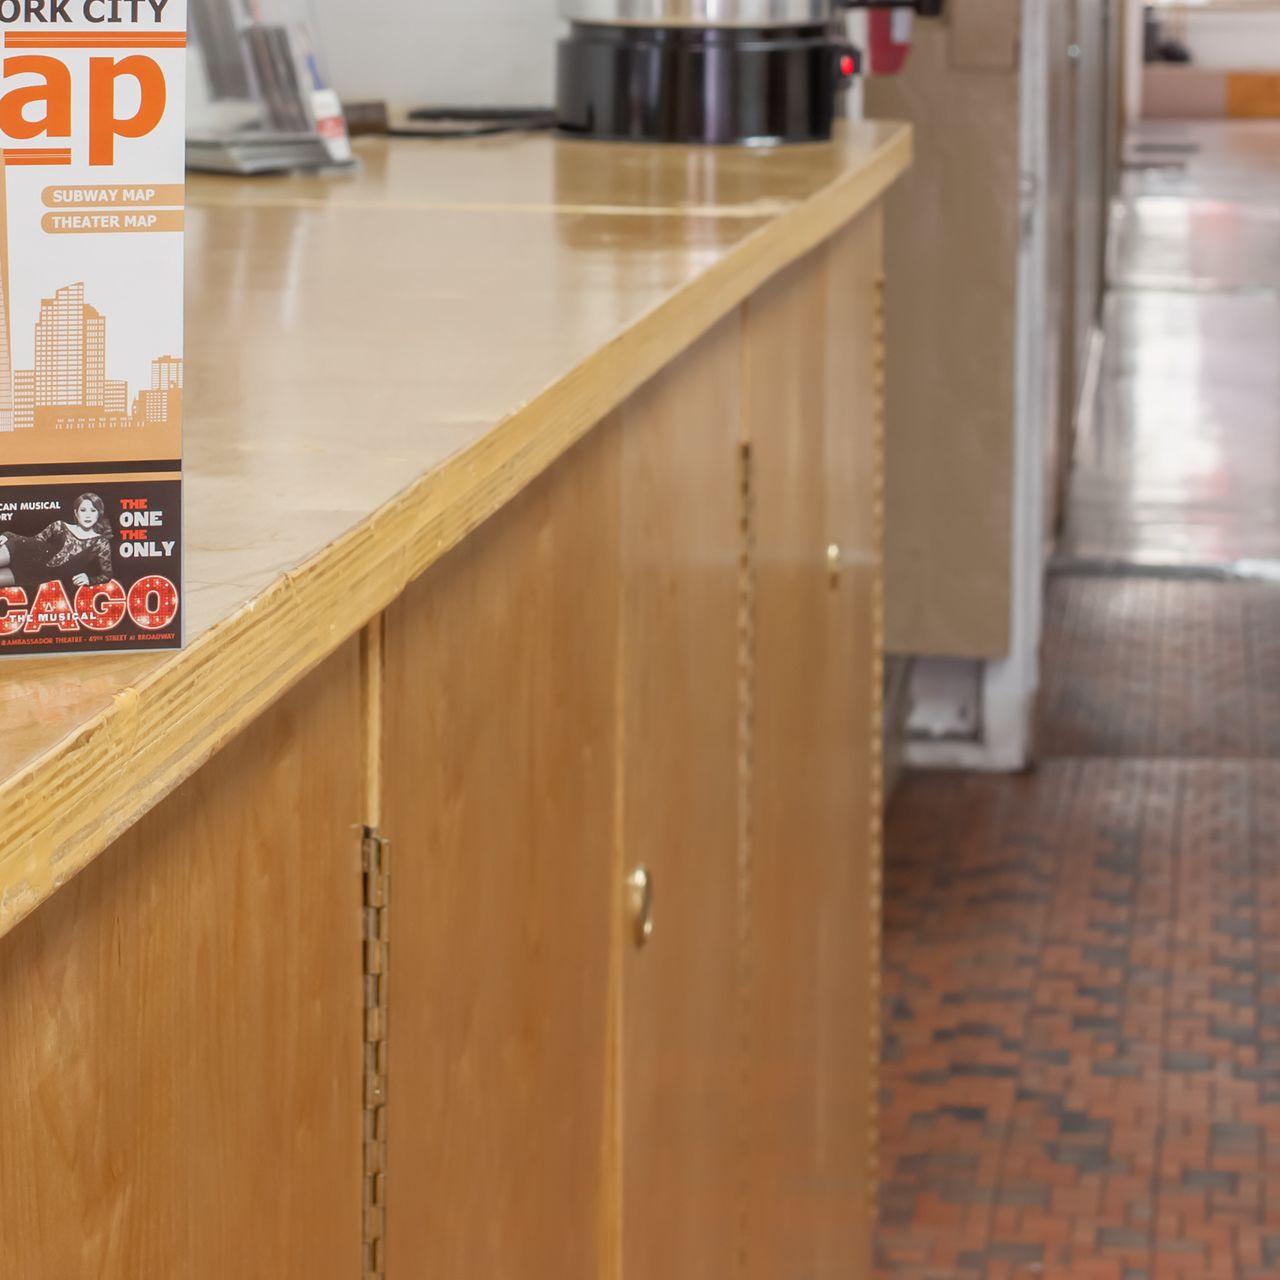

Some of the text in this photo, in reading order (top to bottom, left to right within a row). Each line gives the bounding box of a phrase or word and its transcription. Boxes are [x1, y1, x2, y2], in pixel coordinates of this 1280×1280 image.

[52, 188, 156, 203] SUBWAY MAP
[52, 215, 157, 229] THEATER MAP
[20, 501, 61, 511] MUSICAL
[120, 499, 148, 510] THE
[120, 511, 163, 528] ONE
[120, 529, 148, 540] THE
[119, 541, 175, 558] ONLY
[38, 612, 97, 621] MUSICAL
[105, 634, 128, 642] STREET
[137, 633, 176, 641] BROADWAY
